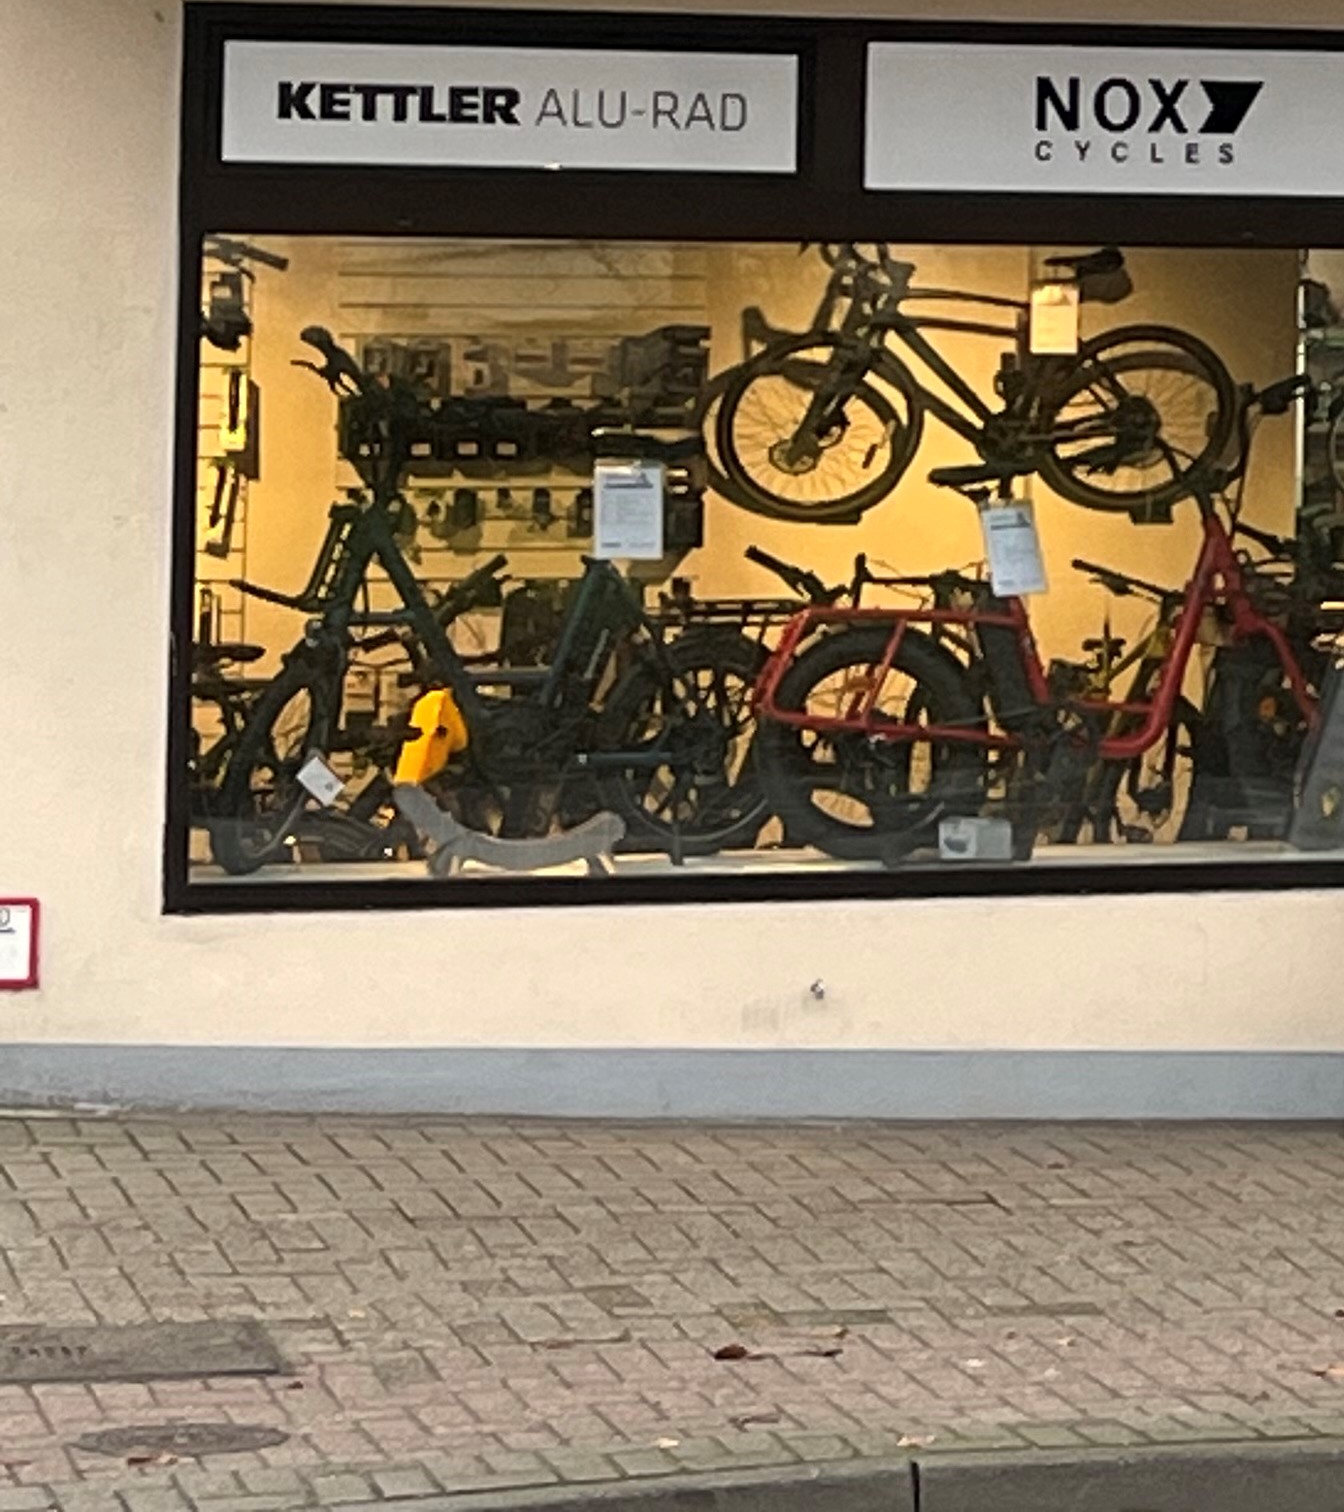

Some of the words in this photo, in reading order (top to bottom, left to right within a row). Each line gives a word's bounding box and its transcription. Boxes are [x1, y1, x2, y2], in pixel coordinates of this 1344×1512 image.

[277, 81, 521, 125] KETTLER
[534, 87, 748, 132] ALU-RAD
[1035, 76, 1189, 134] NOX
[1035, 140, 1235, 164] CYCLES
